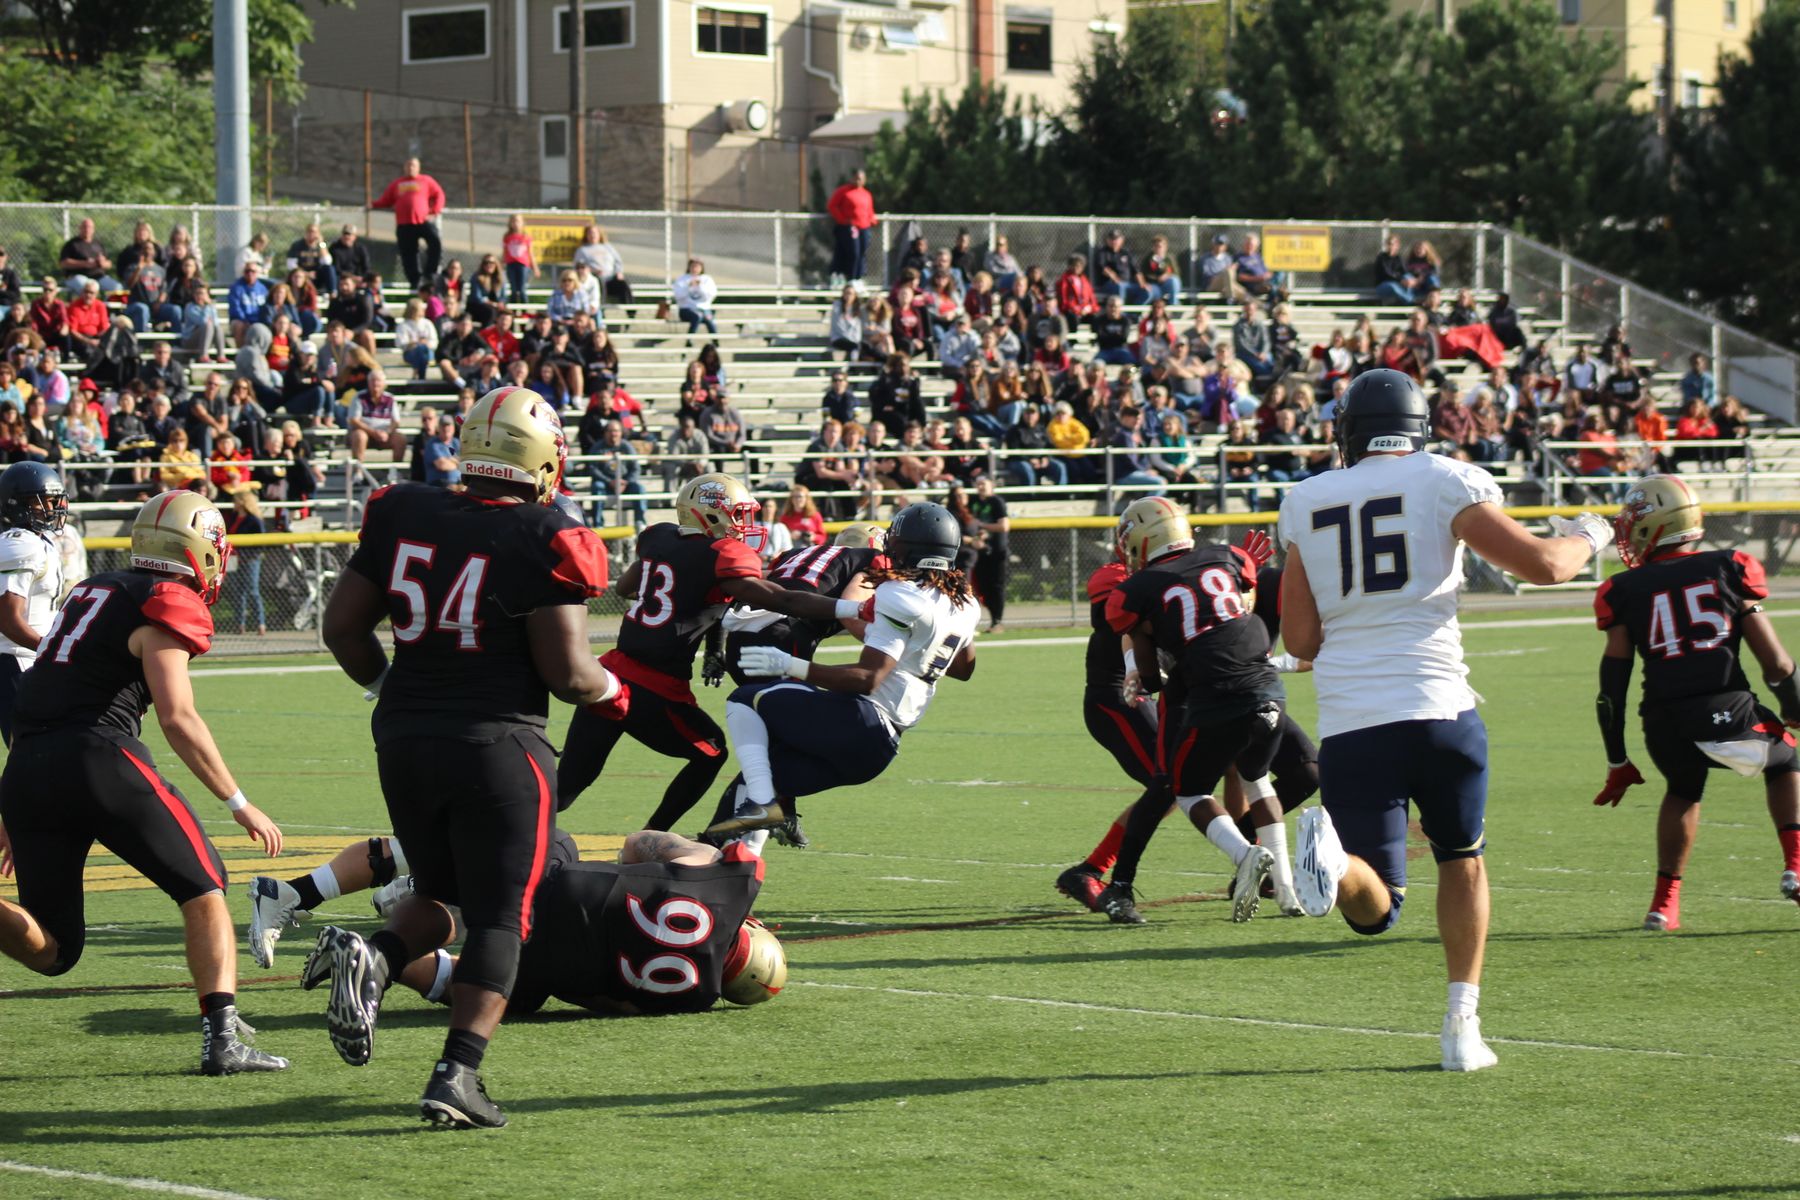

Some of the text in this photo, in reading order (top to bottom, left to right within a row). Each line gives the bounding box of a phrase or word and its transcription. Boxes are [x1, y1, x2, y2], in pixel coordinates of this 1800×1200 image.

[466, 462, 513, 479] Riddell
[134, 558, 169, 571] Riddell
[771, 544, 845, 586] 41
[1311, 494, 1411, 599] 76
[389, 539, 485, 649] 54
[626, 557, 675, 628] 13
[1163, 567, 1246, 644] 28
[1648, 581, 1731, 658] 45
